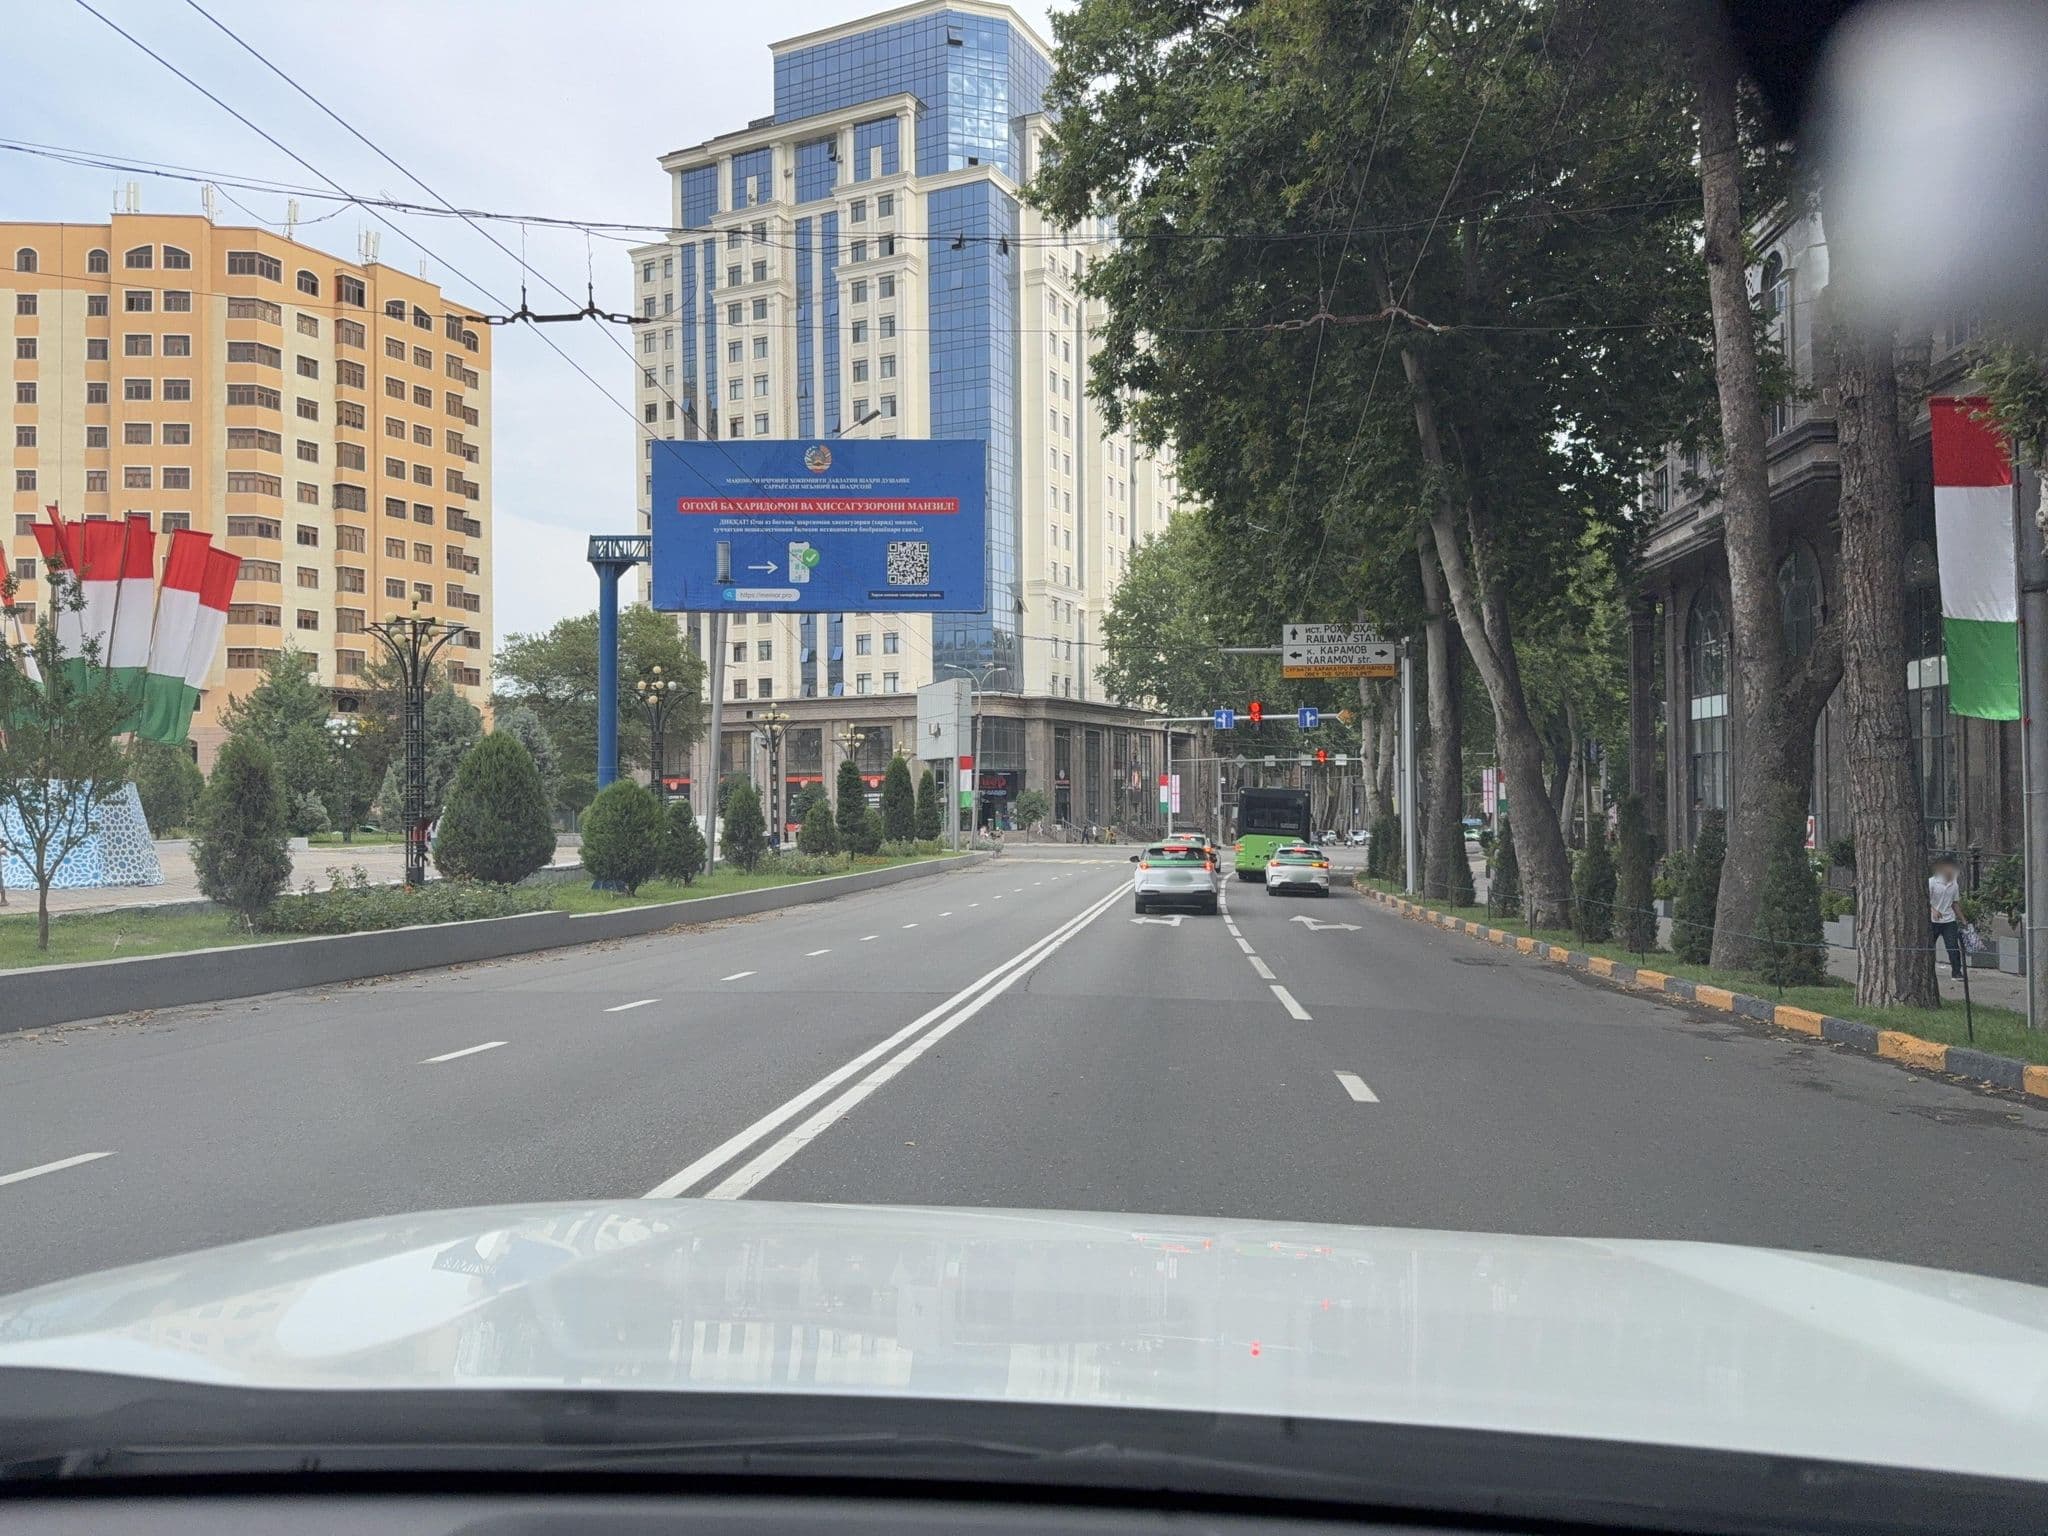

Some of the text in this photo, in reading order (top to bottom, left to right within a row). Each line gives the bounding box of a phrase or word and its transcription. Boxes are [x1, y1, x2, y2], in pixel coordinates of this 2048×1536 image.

[720, 502, 734, 511] БА
[736, 502, 798, 512] ХАРИДОРОН
[801, 502, 814, 511] ВА
[907, 502, 955, 511] МАНЗИЛ!
[1306, 634, 1349, 643] RAILWAY
[1320, 645, 1368, 655] КАРАМОВ
[1306, 655, 1372, 665] KARAMOV str.
